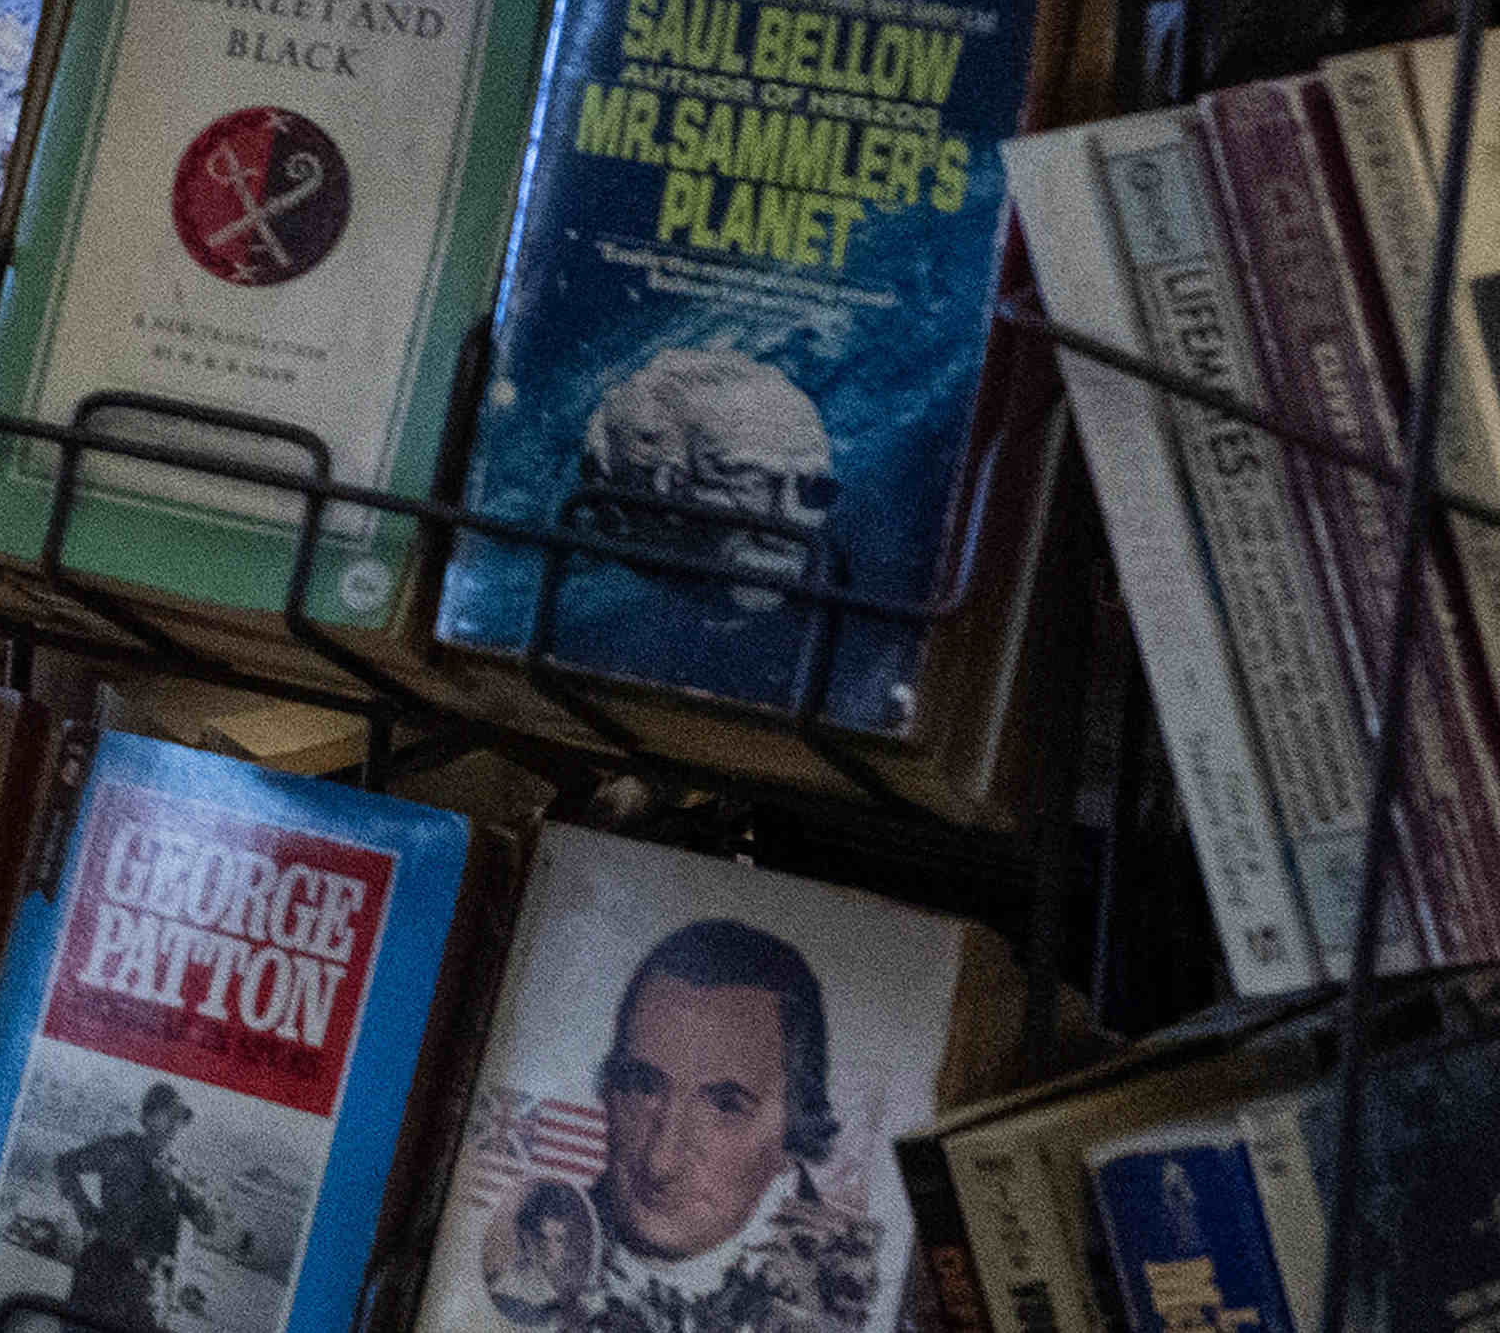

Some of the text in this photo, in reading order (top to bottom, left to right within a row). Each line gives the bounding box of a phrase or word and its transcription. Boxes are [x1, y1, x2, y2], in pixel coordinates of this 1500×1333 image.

[223, 27, 360, 79] BLACK
[752, 6, 964, 108] BELLOW
[655, 172, 864, 271] PLANET
[100, 820, 367, 964] GEORGE
[79, 905, 349, 1049] PATTON
